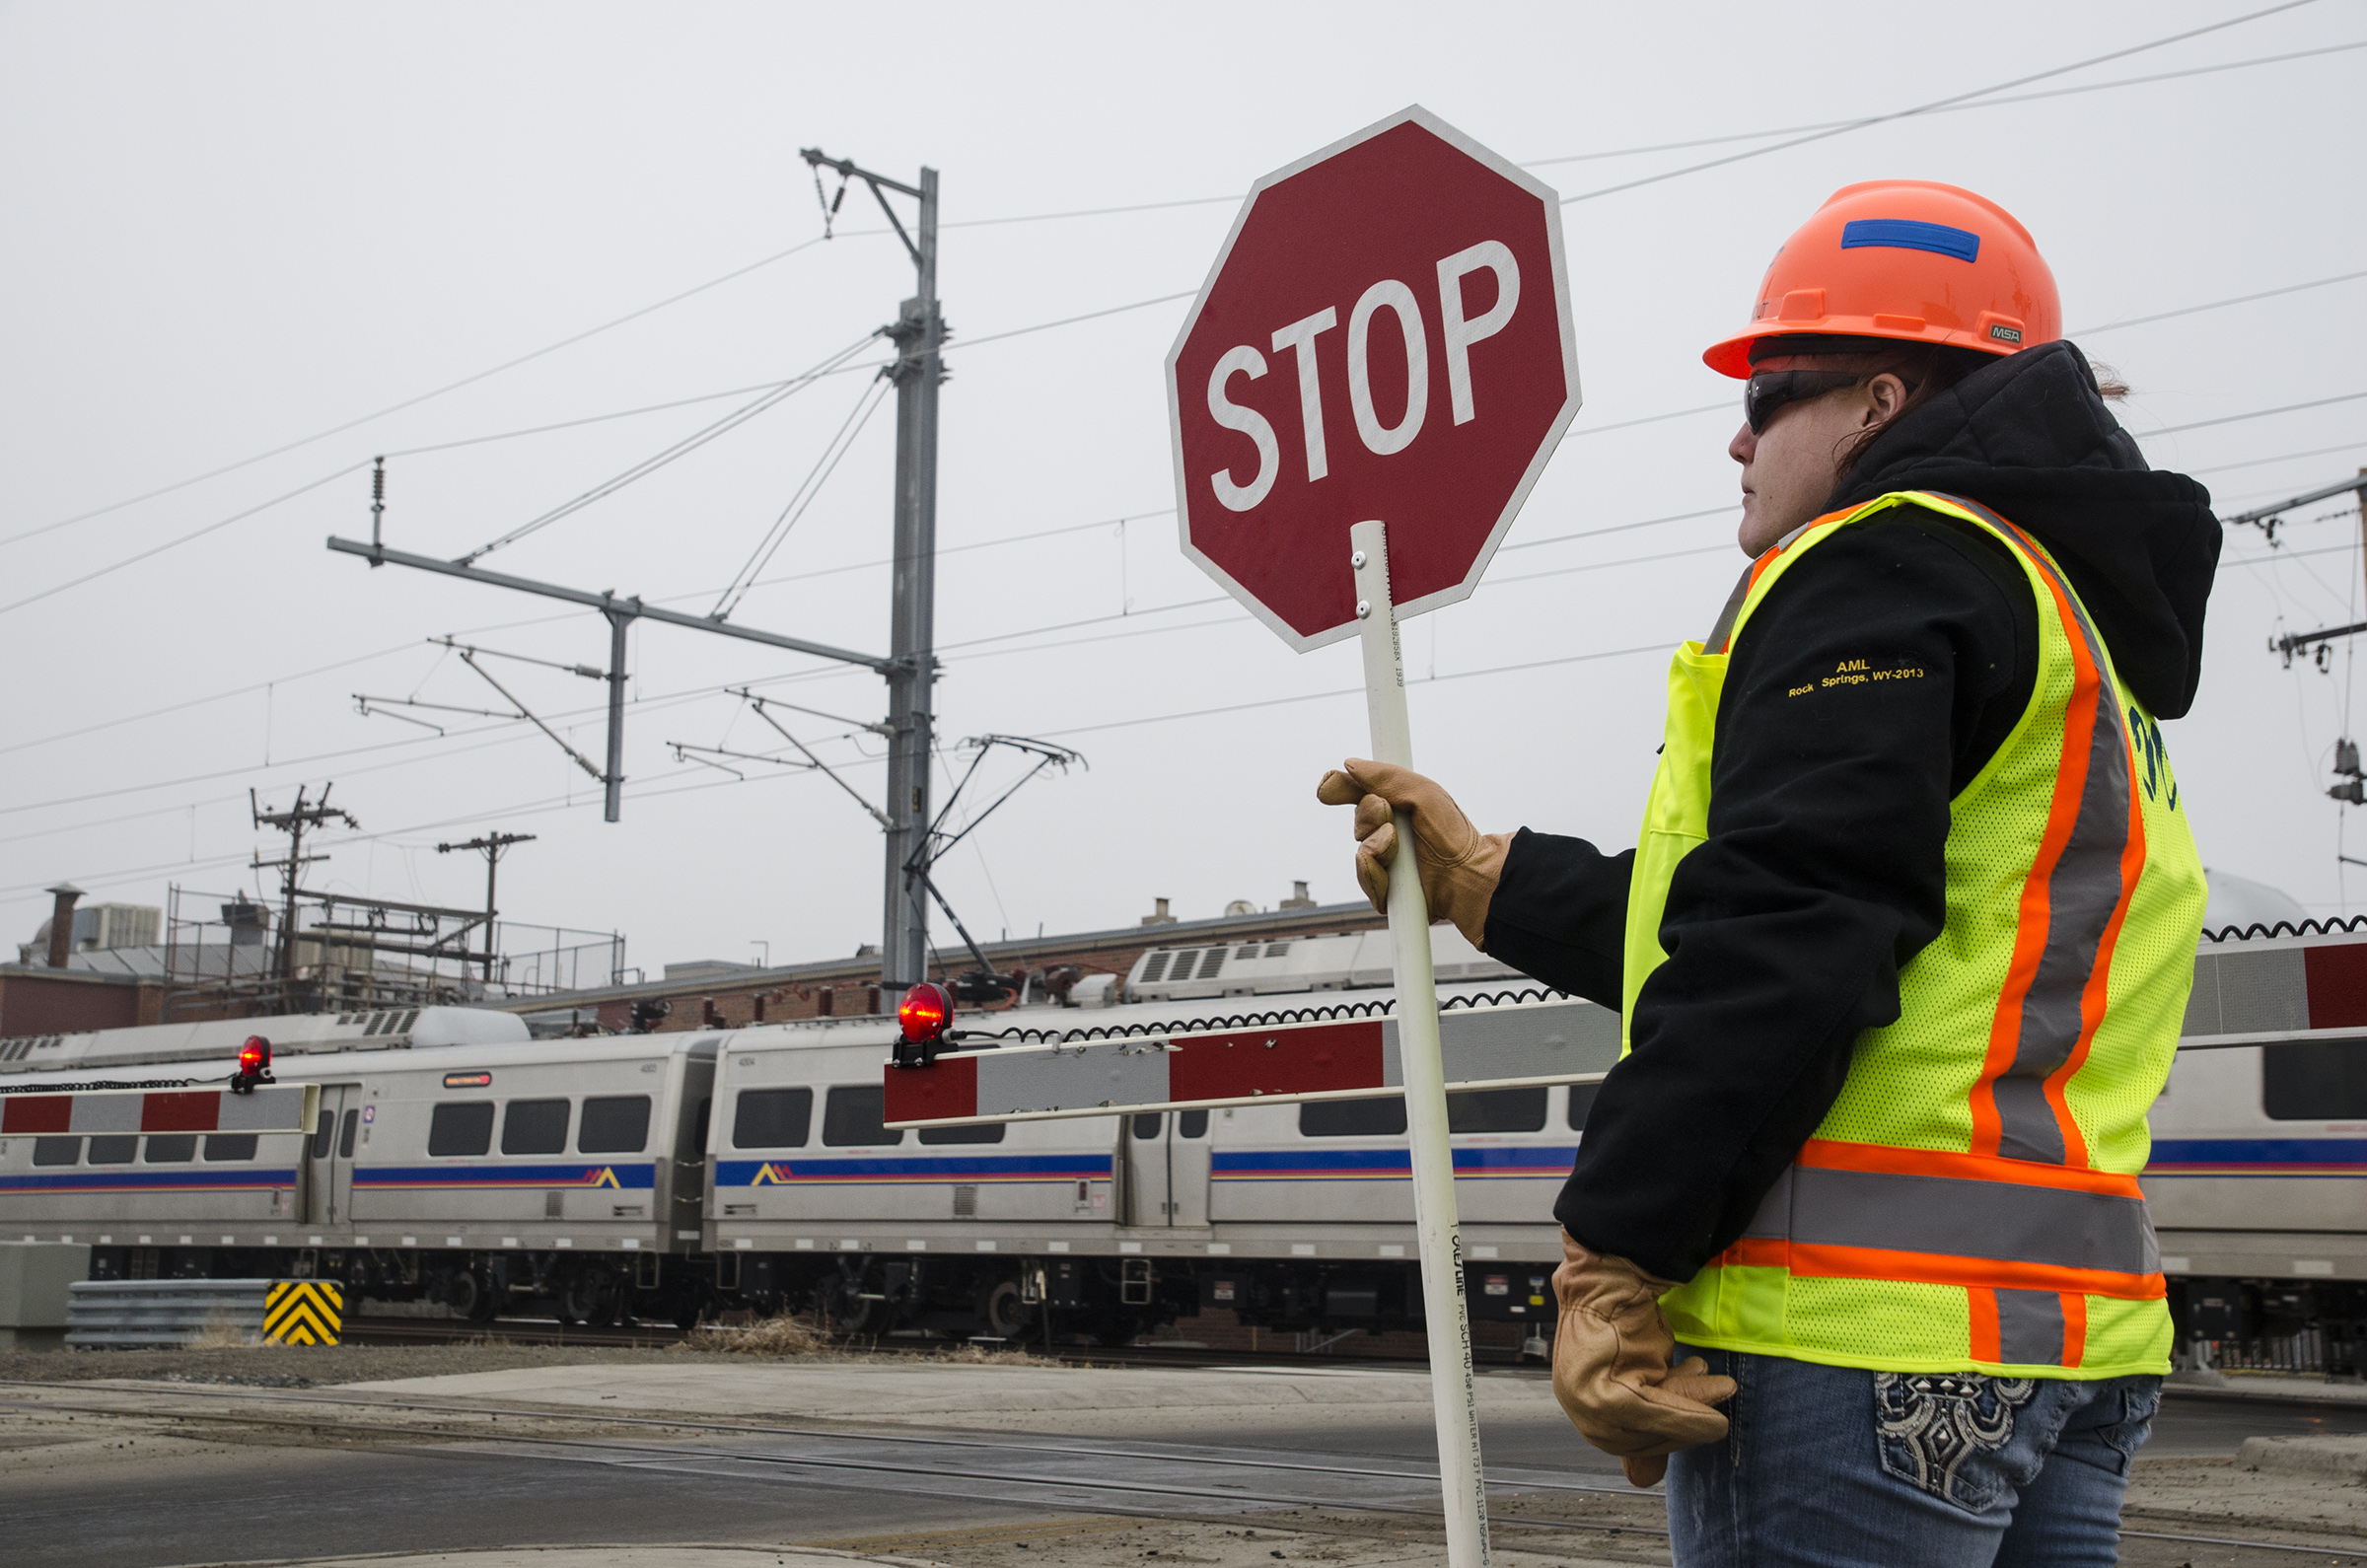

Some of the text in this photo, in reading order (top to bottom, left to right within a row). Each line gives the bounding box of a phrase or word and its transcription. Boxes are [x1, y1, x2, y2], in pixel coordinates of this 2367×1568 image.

[1993, 327, 2019, 341] MSA
[1207, 240, 1521, 512] STOP
[1835, 659, 1871, 674] AML
[1788, 668, 1924, 698] Rock Springs, WY-2013
[1458, 1304, 1467, 1321] PVC
[1460, 1323, 1471, 1350] SCH
[1463, 1352, 1472, 1369] 40
[1466, 1391, 1474, 1408] PSI
[1468, 1409, 1478, 1440] WATER
[1471, 1441, 1479, 1454] AT
[1474, 1478, 1483, 1497] PVC
[1475, 1499, 1485, 1522] 1120
